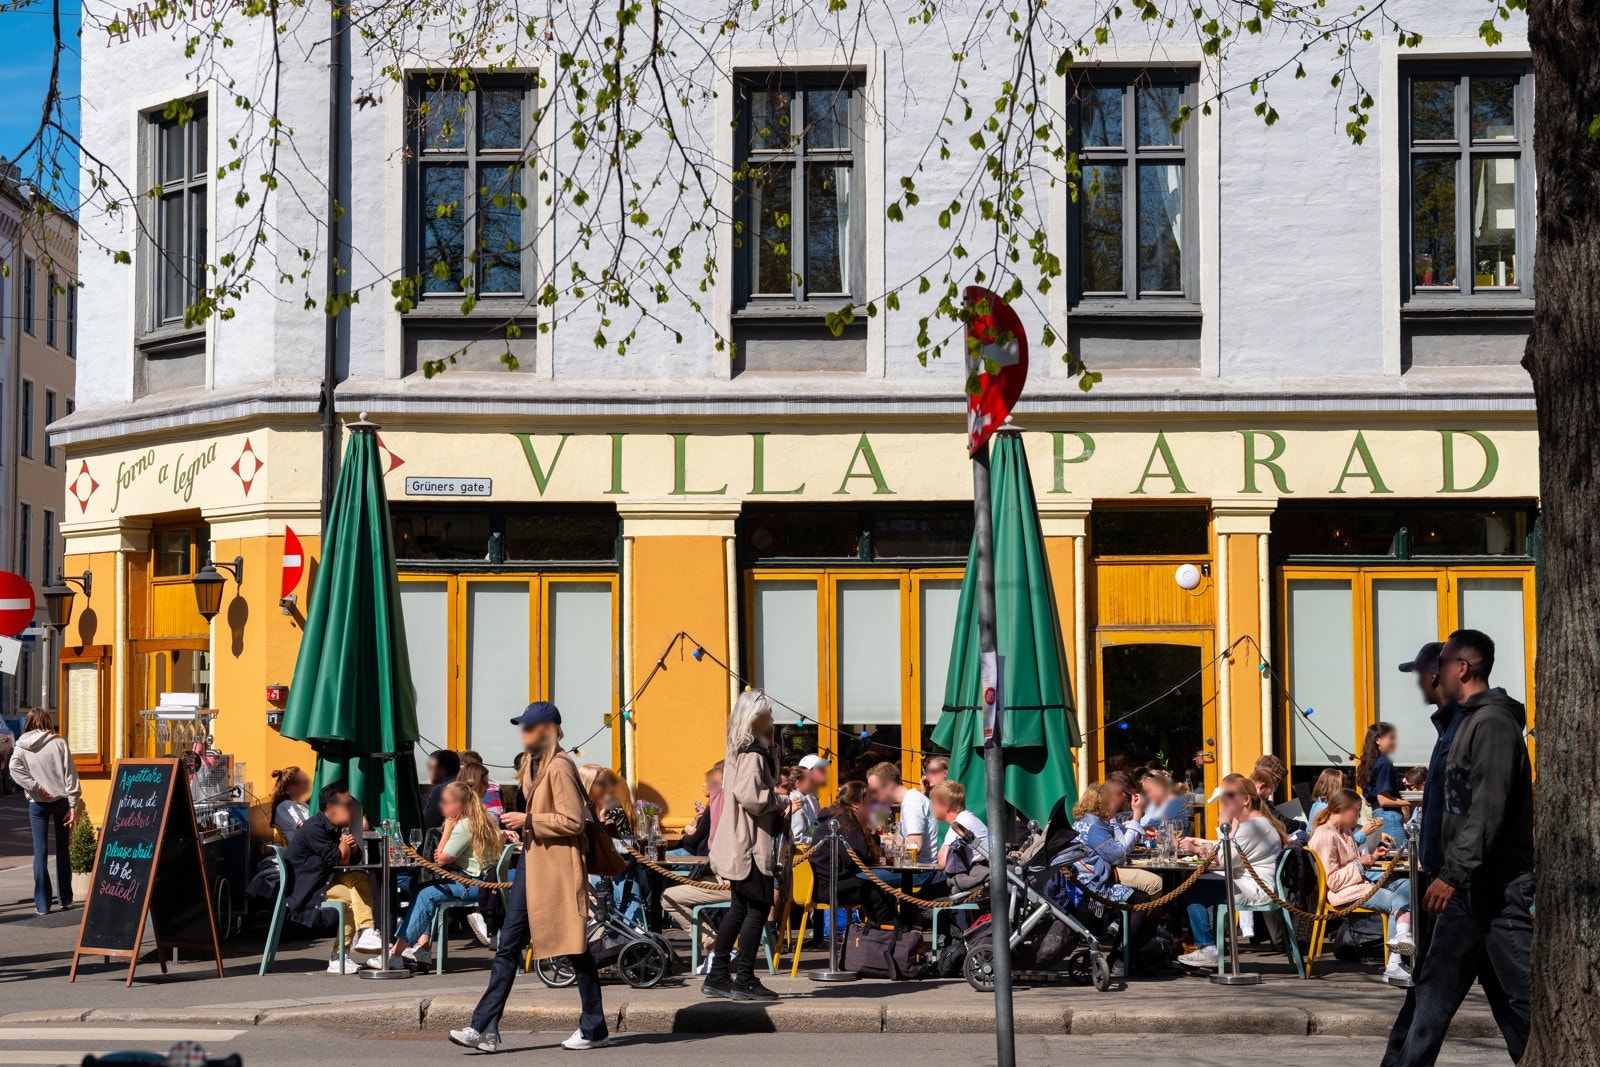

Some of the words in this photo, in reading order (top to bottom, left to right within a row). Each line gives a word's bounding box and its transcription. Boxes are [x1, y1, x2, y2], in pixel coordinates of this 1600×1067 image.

[510, 431, 898, 497] VILLA
[1045, 429, 1500, 494] PARAD
[110, 449, 155, 513] forno
[158, 464, 169, 484] a
[173, 442, 218, 502] legna
[412, 480, 455, 491] Grüners
[460, 482, 485, 494] gate
[119, 767, 162, 795] Aspettare
[115, 794, 143, 818] prima
[145, 790, 157, 807] di
[132, 842, 153, 859] wait
[109, 860, 120, 875] to
[120, 861, 132, 880] be
